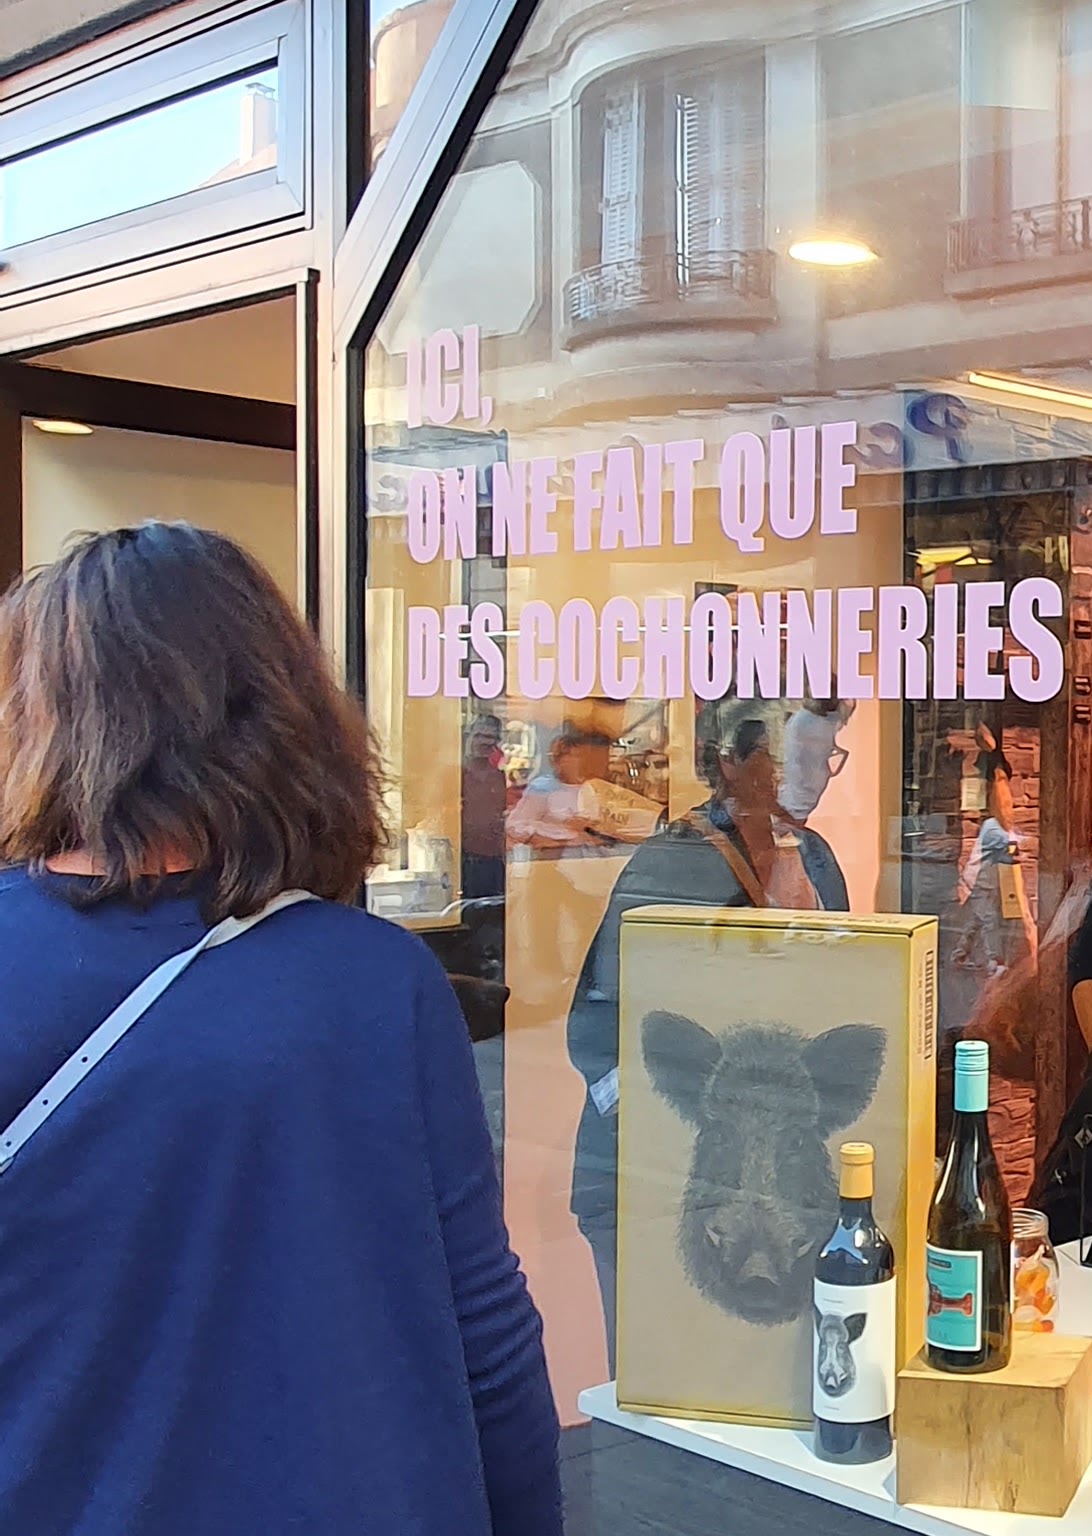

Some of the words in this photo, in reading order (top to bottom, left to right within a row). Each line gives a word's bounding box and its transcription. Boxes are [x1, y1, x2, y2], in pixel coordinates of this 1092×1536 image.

[407, 324, 493, 429] ICI,
[407, 465, 477, 564] ON
[492, 456, 558, 557] NE
[573, 439, 704, 552] FAIT
[719, 421, 858, 553] QUE
[407, 602, 504, 699] DES
[518, 577, 1065, 703] COCHONNERIES
